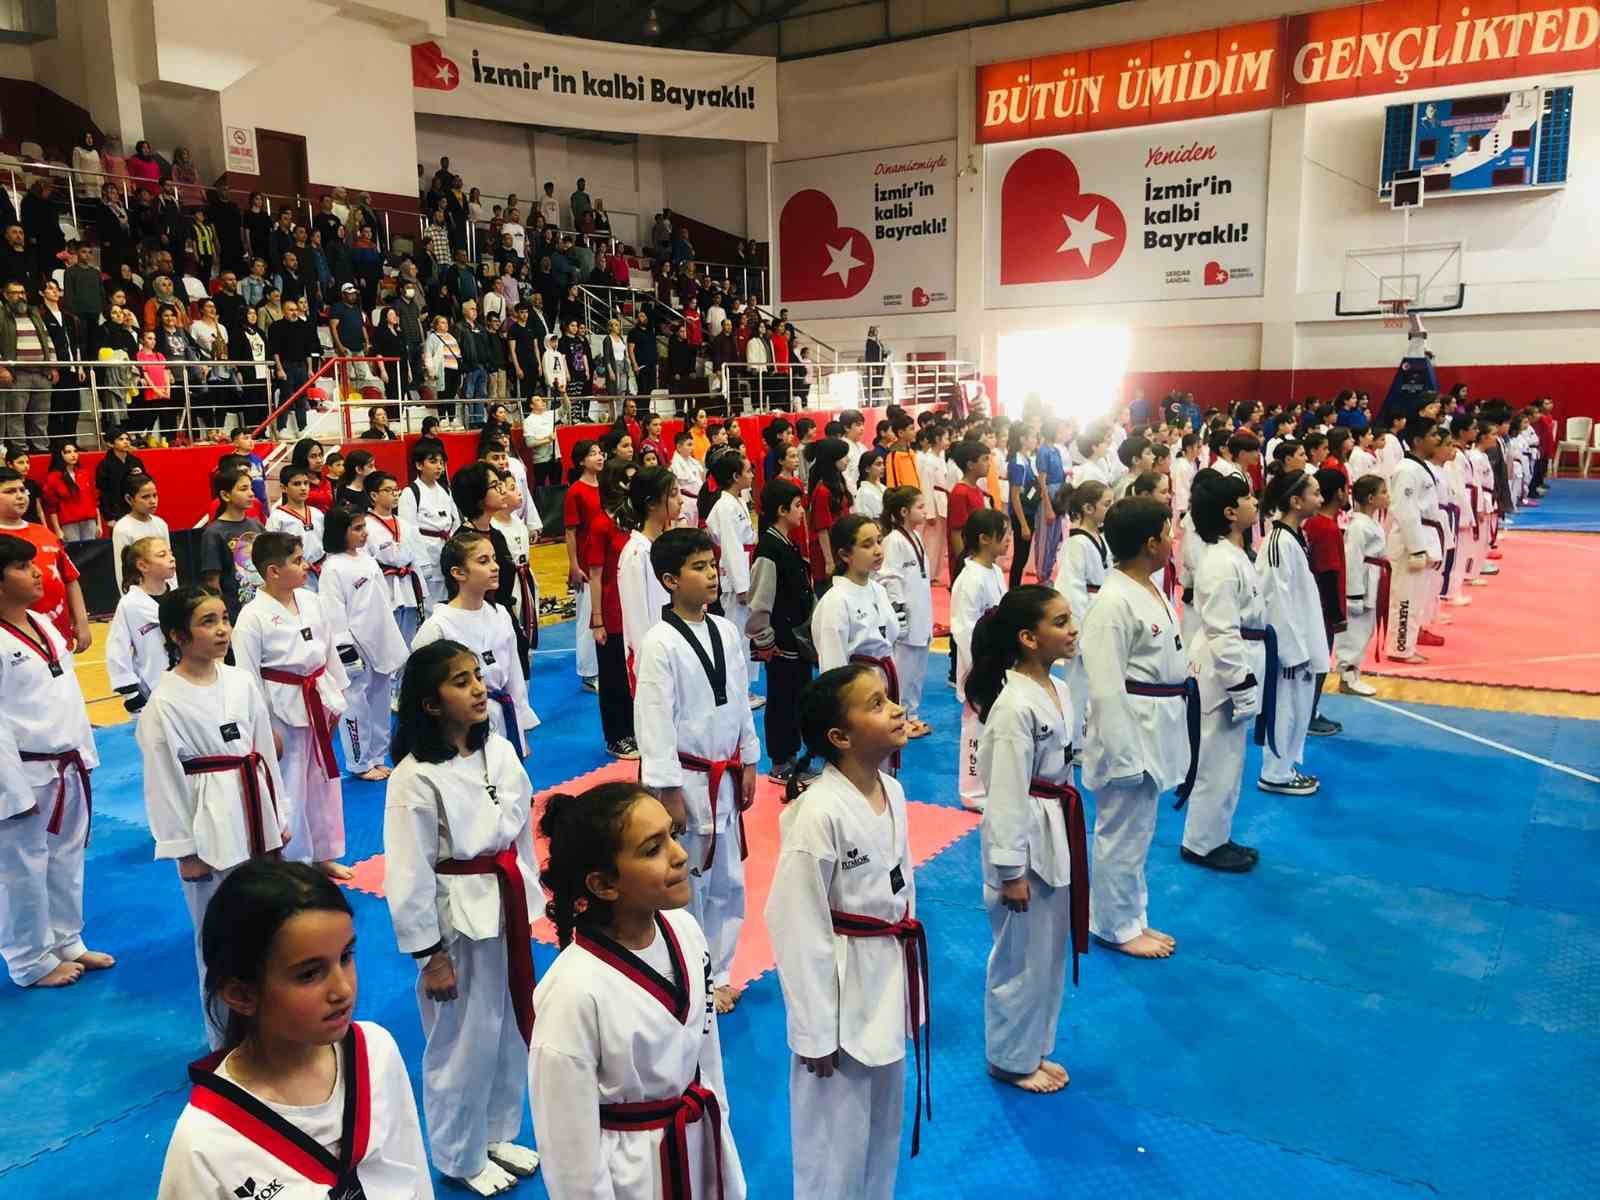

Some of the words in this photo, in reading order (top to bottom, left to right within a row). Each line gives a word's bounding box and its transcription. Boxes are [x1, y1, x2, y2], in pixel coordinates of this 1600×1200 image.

[983, 66, 1104, 127] BÜTÜN
[1116, 42, 1275, 111] ÜMİDİM
[1293, 5, 1600, 84] GENÇLİKTED
[471, 49, 577, 96] İzmir'in
[583, 70, 645, 102] kalbi
[651, 78, 756, 111] Bayraklı!
[1145, 141, 1217, 168] Yeniden
[874, 201, 913, 221] kalbi
[1144, 201, 1200, 225] kalbi
[875, 217, 947, 241] Bayraklı!
[1144, 223, 1249, 252] Bayraklı!
[553, 356, 562, 370] A
[1397, 600, 1409, 652] TAEKWONDO
